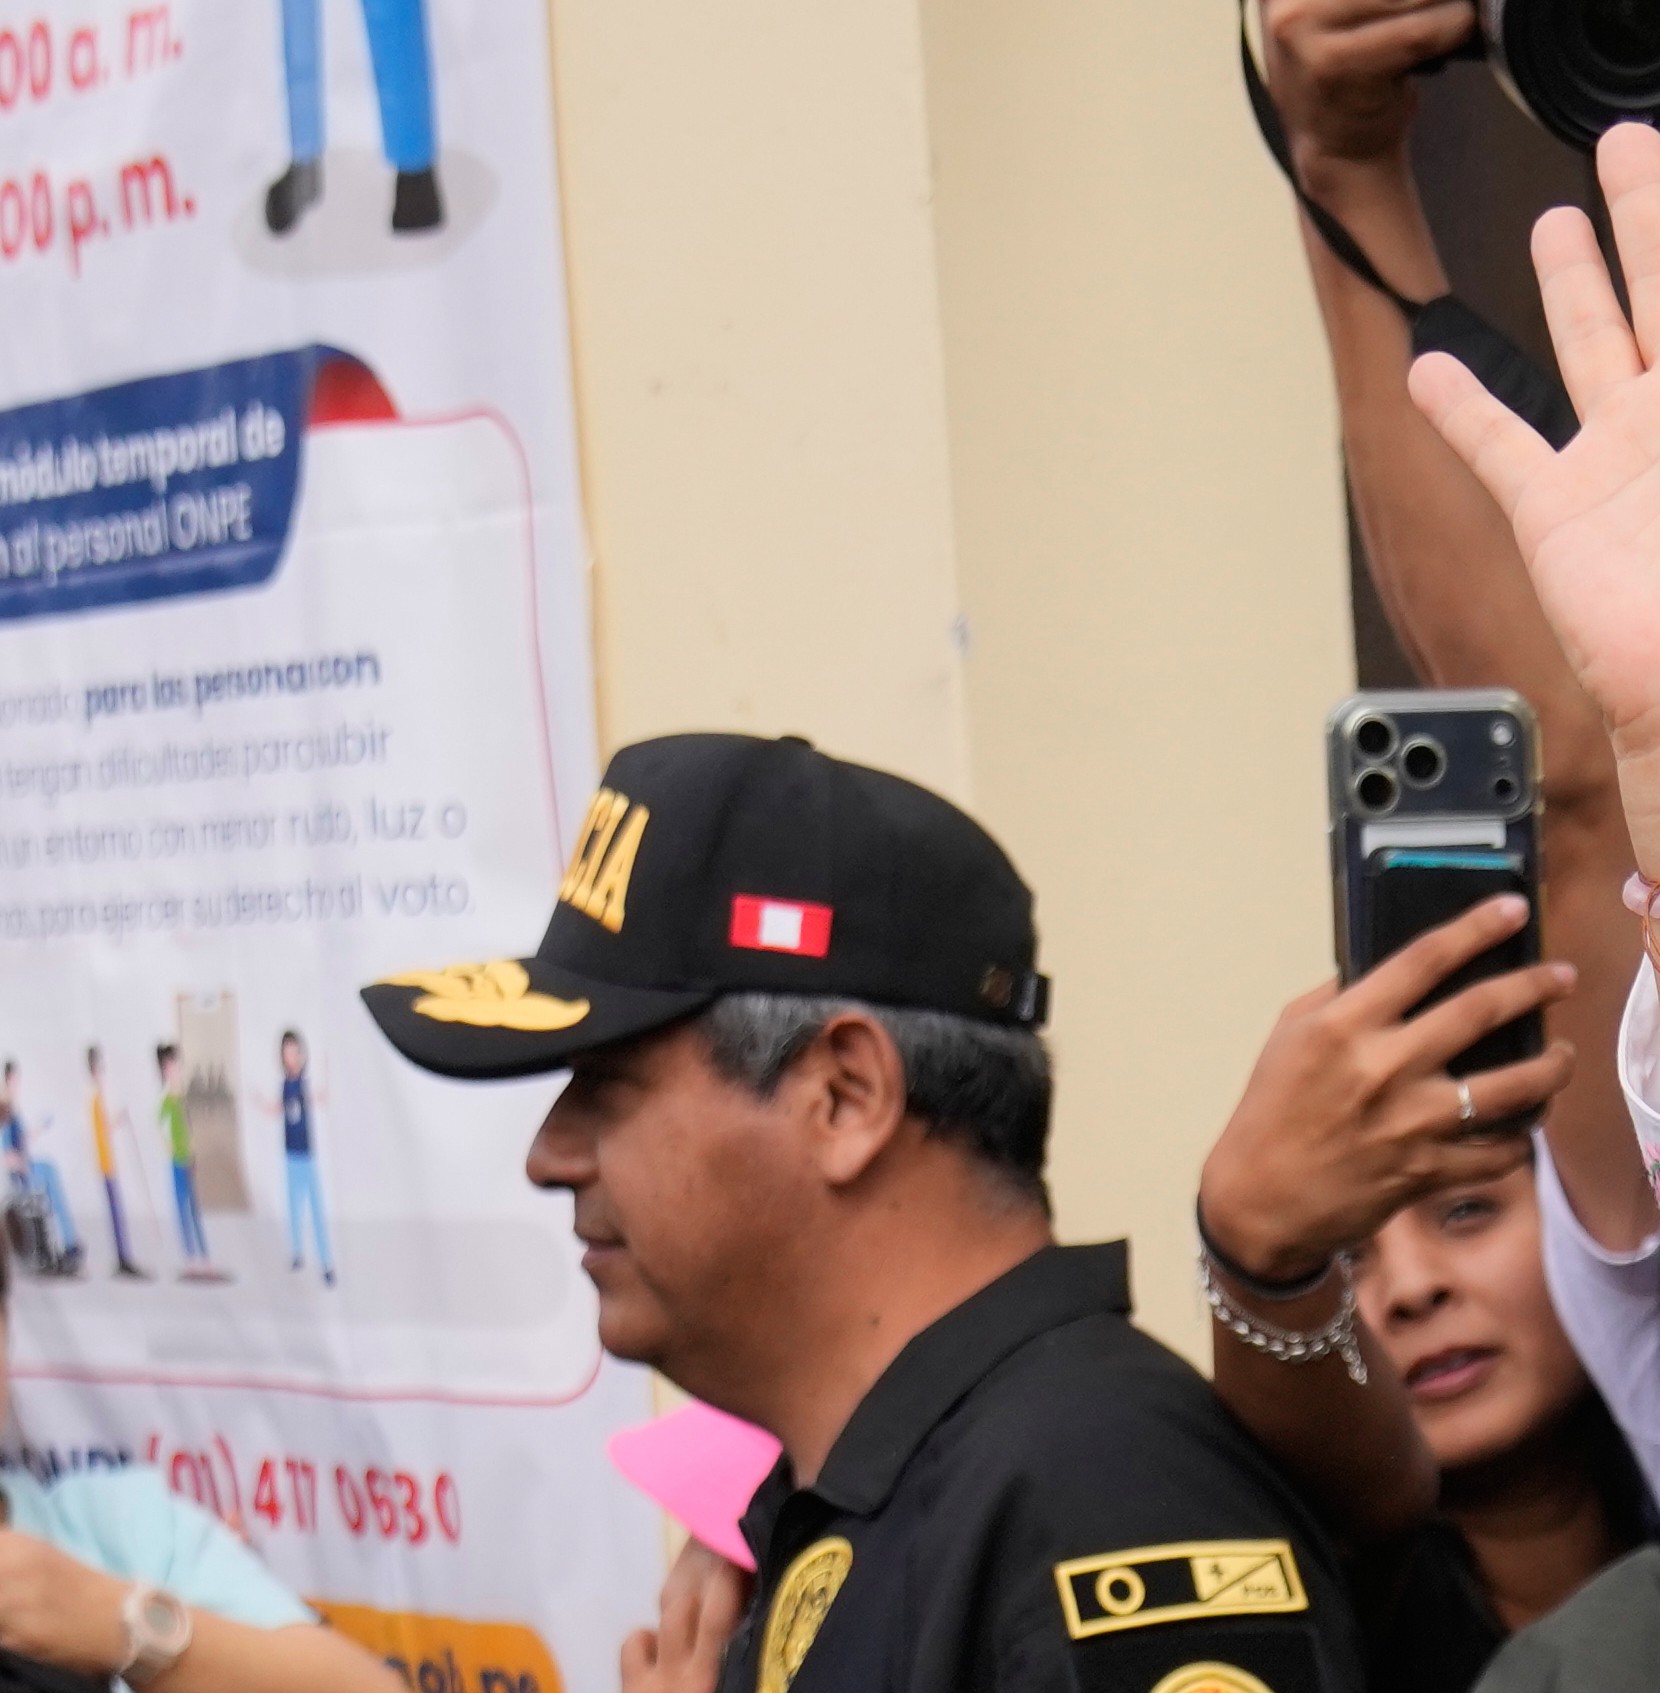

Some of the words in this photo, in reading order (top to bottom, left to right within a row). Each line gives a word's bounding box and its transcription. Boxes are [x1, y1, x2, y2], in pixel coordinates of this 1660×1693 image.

[67, 181, 110, 278] p.
[120, 156, 195, 230] m.
[97, 406, 238, 495] temporal
[239, 401, 286, 462] de
[43, 498, 170, 588] personal
[169, 482, 253, 550] ONPE
[368, 794, 427, 842] luz
[436, 799, 468, 841] o
[333, 1464, 462, 1545] 0630
